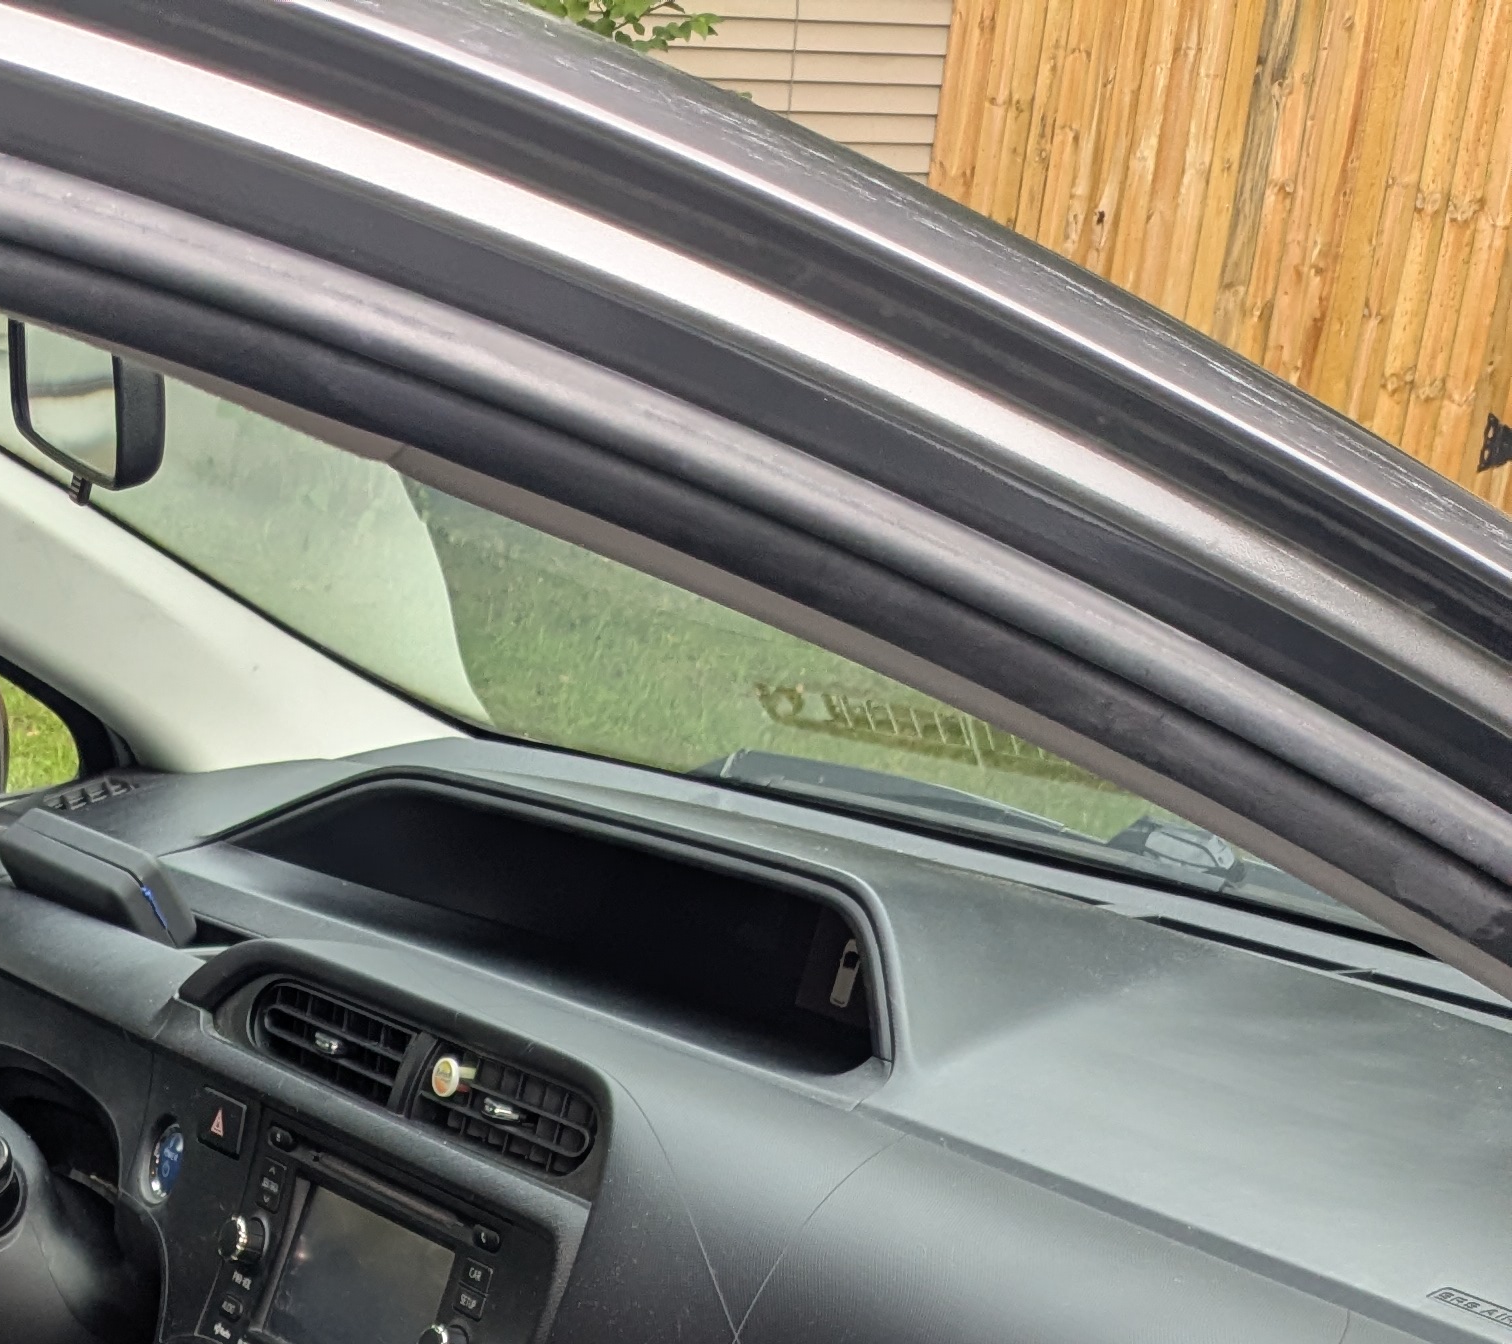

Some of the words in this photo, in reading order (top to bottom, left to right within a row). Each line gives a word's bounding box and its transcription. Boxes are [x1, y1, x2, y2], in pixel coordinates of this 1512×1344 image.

[468, 1267, 482, 1282] CAR
[459, 1293, 477, 1309] SETUP
[1438, 1291, 1481, 1309] SRS
